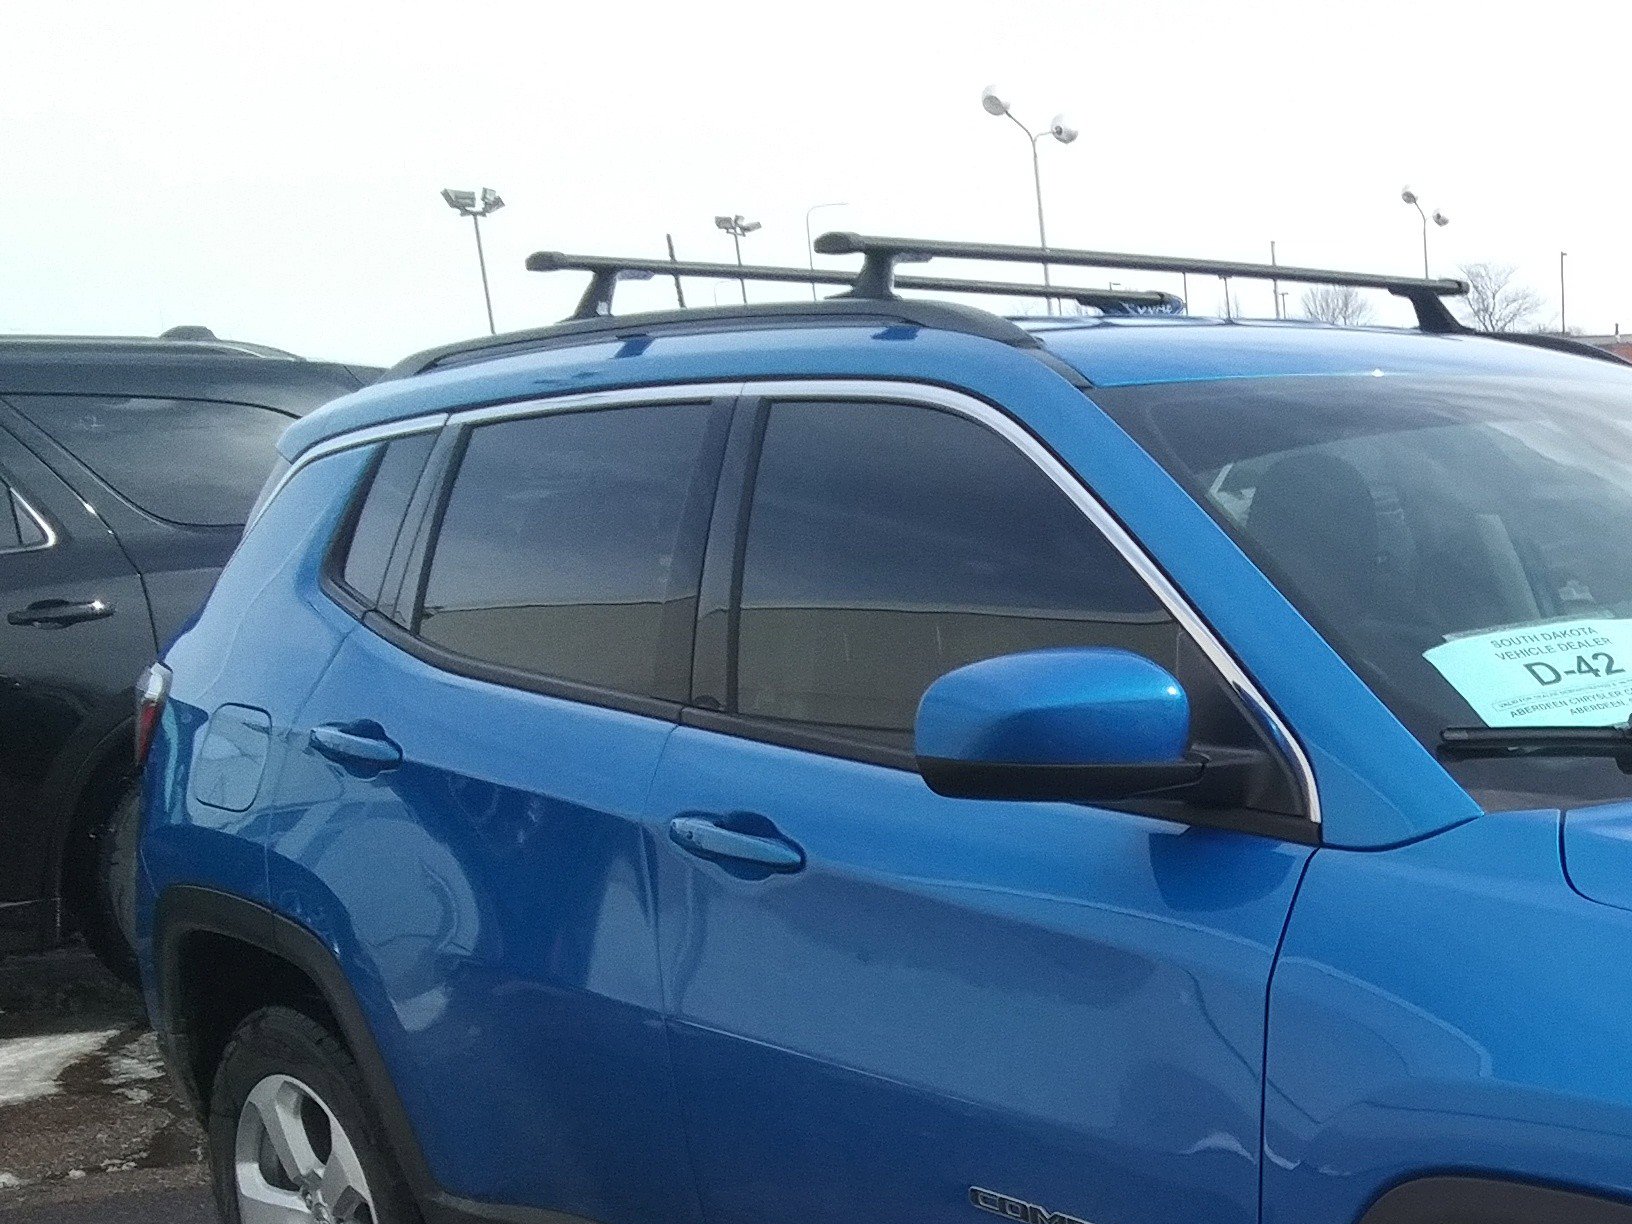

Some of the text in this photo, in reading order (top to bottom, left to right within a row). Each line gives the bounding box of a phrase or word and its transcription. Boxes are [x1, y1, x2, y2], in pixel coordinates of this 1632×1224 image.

[1490, 626, 1599, 648] SOUTH DAKOTA
[1494, 637, 1613, 660] VEHICLE DEALER
[1522, 652, 1627, 686] D-42
[1510, 700, 1568, 718] ABERDEEN
[1569, 689, 1622, 705] CHRYSLER
